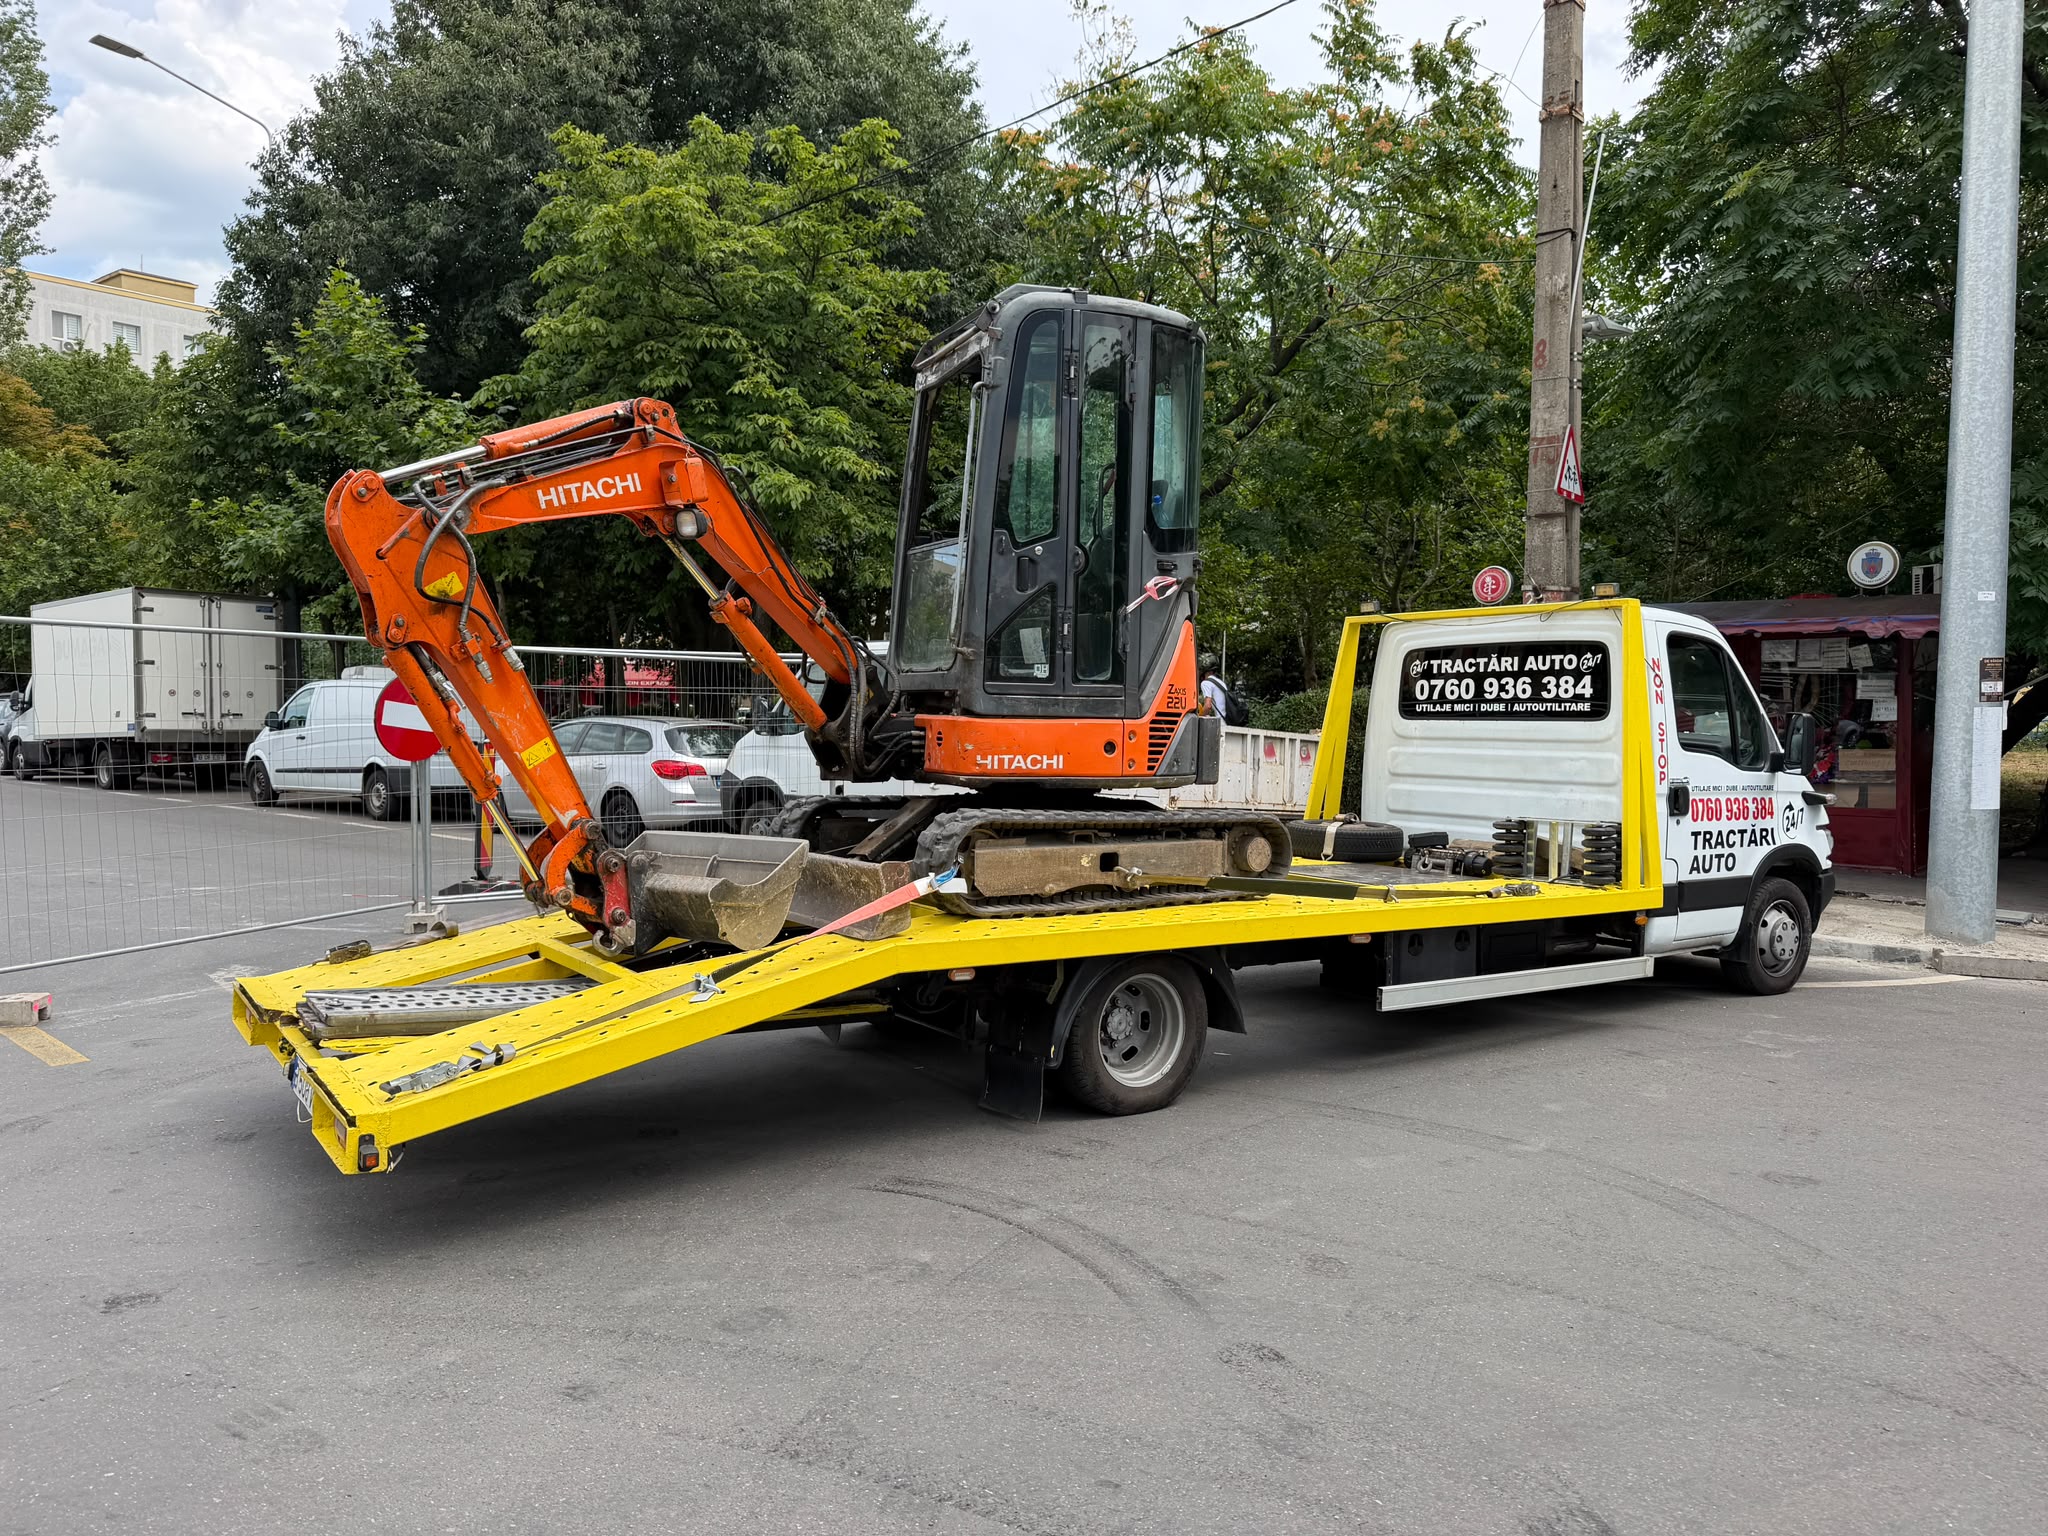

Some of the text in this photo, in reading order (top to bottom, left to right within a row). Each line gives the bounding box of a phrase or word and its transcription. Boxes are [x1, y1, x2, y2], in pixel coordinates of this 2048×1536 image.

[537, 473, 642, 510] HITACHI
[1430, 653, 1519, 674] TRACTĂRI
[1524, 654, 1578, 671] AUTO
[1581, 653, 1602, 671] 24/7
[1415, 675, 1593, 700] 0760 936 384
[1166, 696, 1187, 709] 22U
[1416, 703, 1591, 712] UTILAJE MICI DUBE AUTOUTILITARE
[1652, 658, 1667, 785] NON STOP
[976, 754, 1064, 770] HITACHI
[1691, 784, 1775, 792] UTILAJE MICI DUBE AUTOUTILITARE
[1691, 796, 1774, 823] 0760 936 384
[1784, 806, 1804, 834] 24/7
[1691, 823, 1777, 851] TRACTĂRI
[1688, 852, 1737, 875] AUTO
